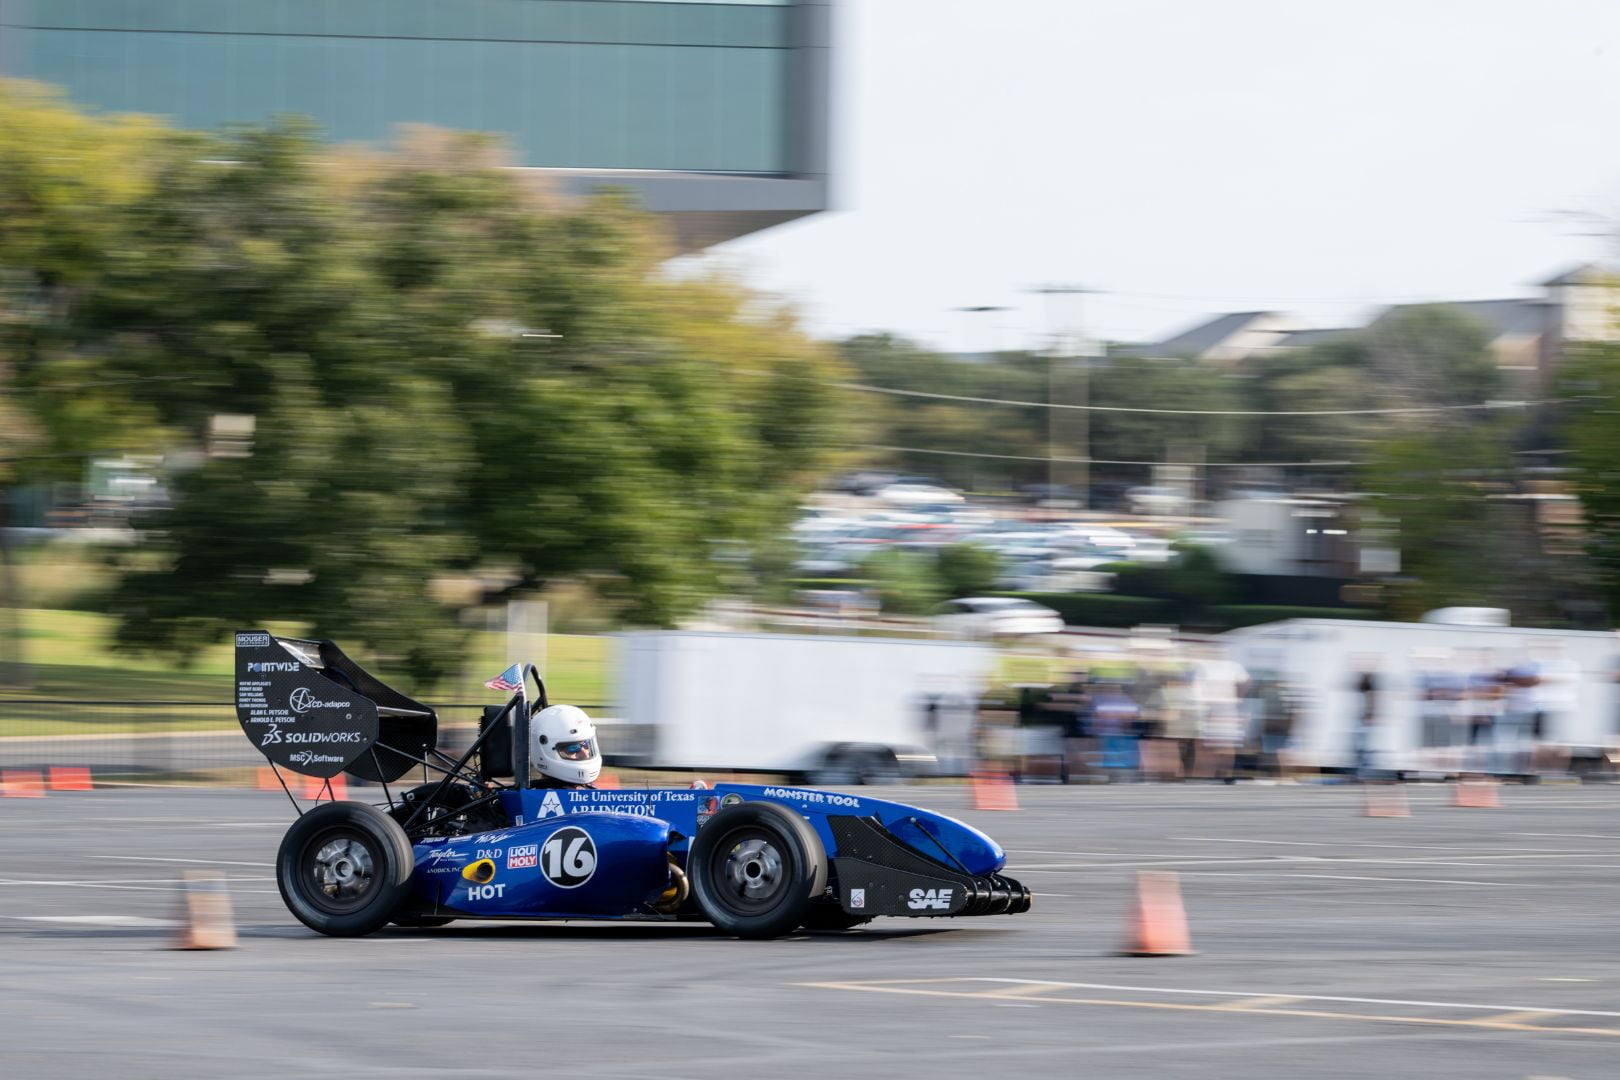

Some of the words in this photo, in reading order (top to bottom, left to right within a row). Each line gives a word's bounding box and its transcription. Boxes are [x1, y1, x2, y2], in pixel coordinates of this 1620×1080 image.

[247, 662, 300, 672] POINTWISE
[312, 700, 350, 710] CD-adapco
[286, 732, 360, 743] SOLIDWORKS
[568, 791, 588, 802] The
[591, 791, 649, 804] University
[651, 791, 662, 802] of
[663, 792, 695, 802] Texas
[764, 787, 824, 802] MONSTER
[825, 794, 860, 808] TOOL
[476, 849, 502, 859] D&D
[510, 846, 536, 856] LIQUI
[509, 856, 536, 867] MOLY
[544, 836, 595, 878] 16
[468, 884, 505, 900] HOT
[907, 888, 953, 909] SAE
